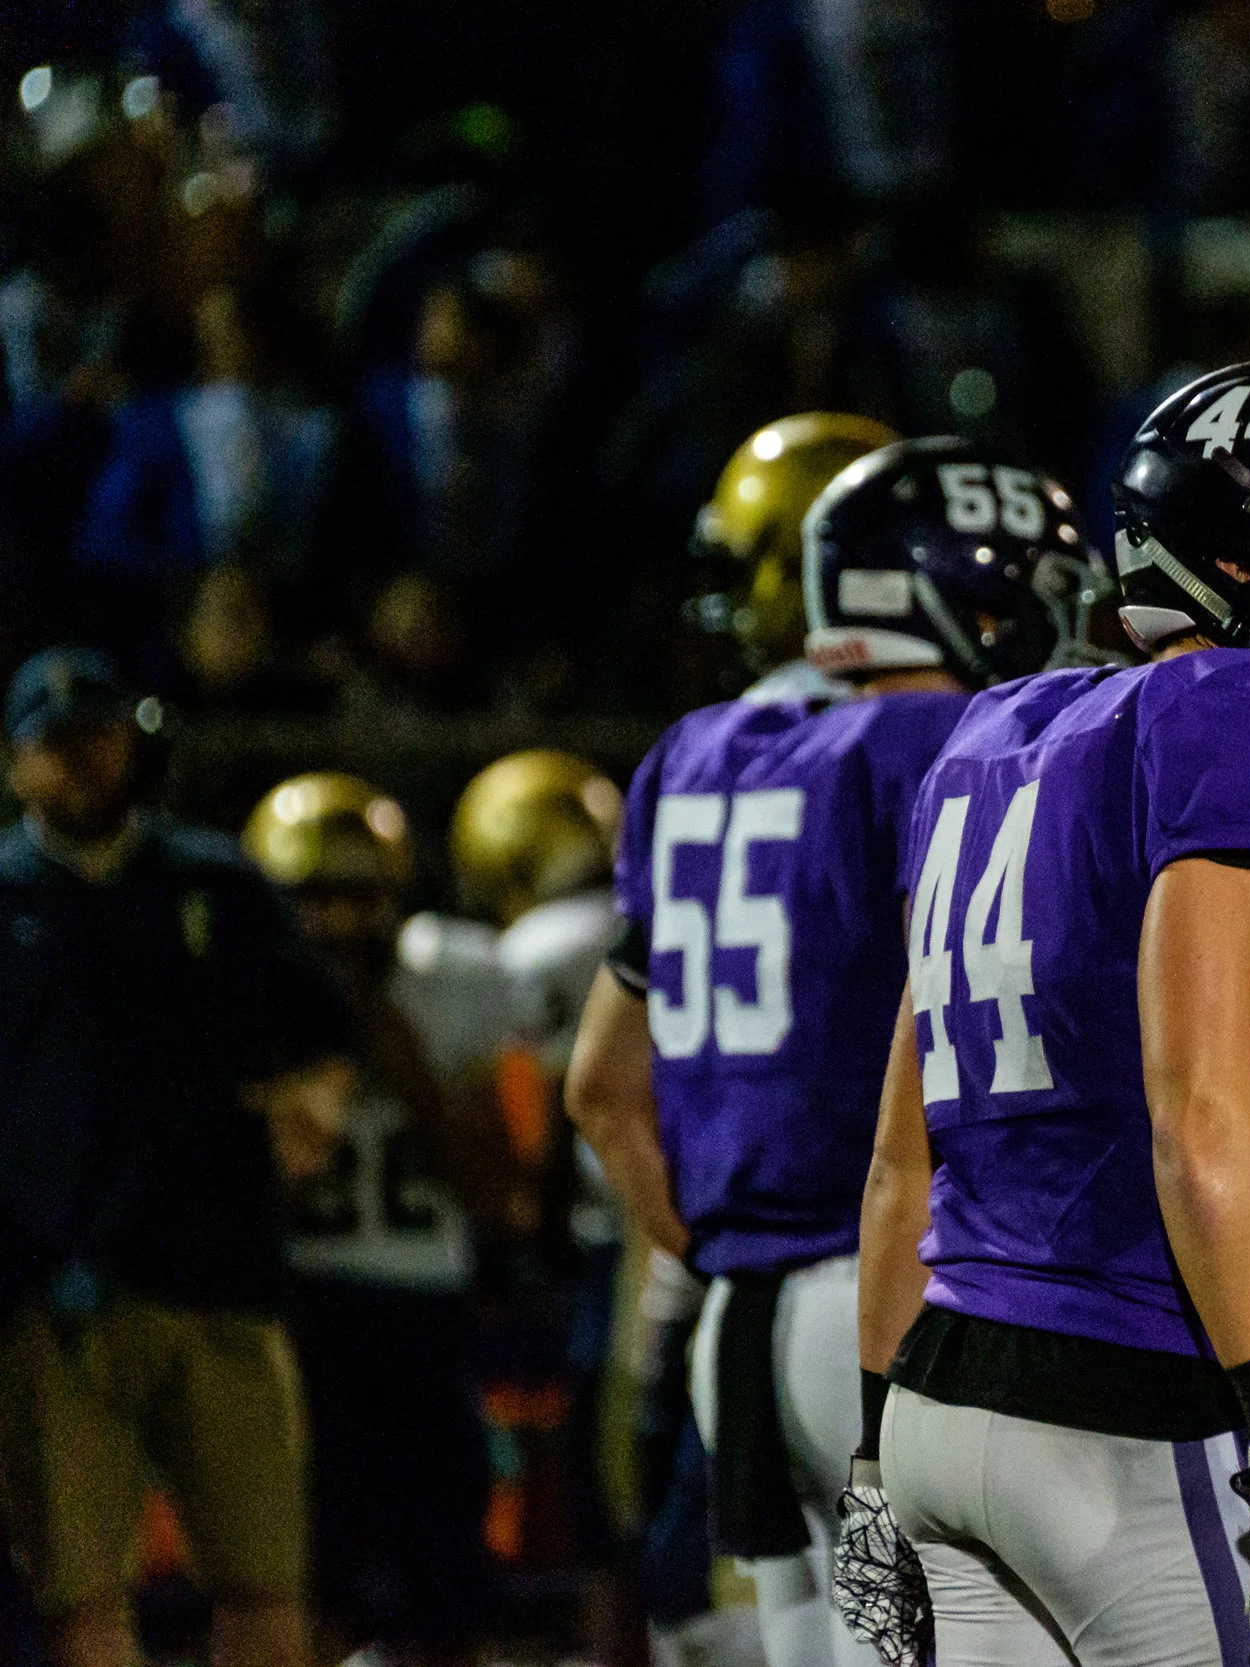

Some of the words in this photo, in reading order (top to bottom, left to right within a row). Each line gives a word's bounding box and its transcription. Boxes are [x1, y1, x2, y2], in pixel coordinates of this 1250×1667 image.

[936, 464, 1045, 538] 55
[648, 788, 805, 1058] 55
[908, 779, 1053, 1106] 44
